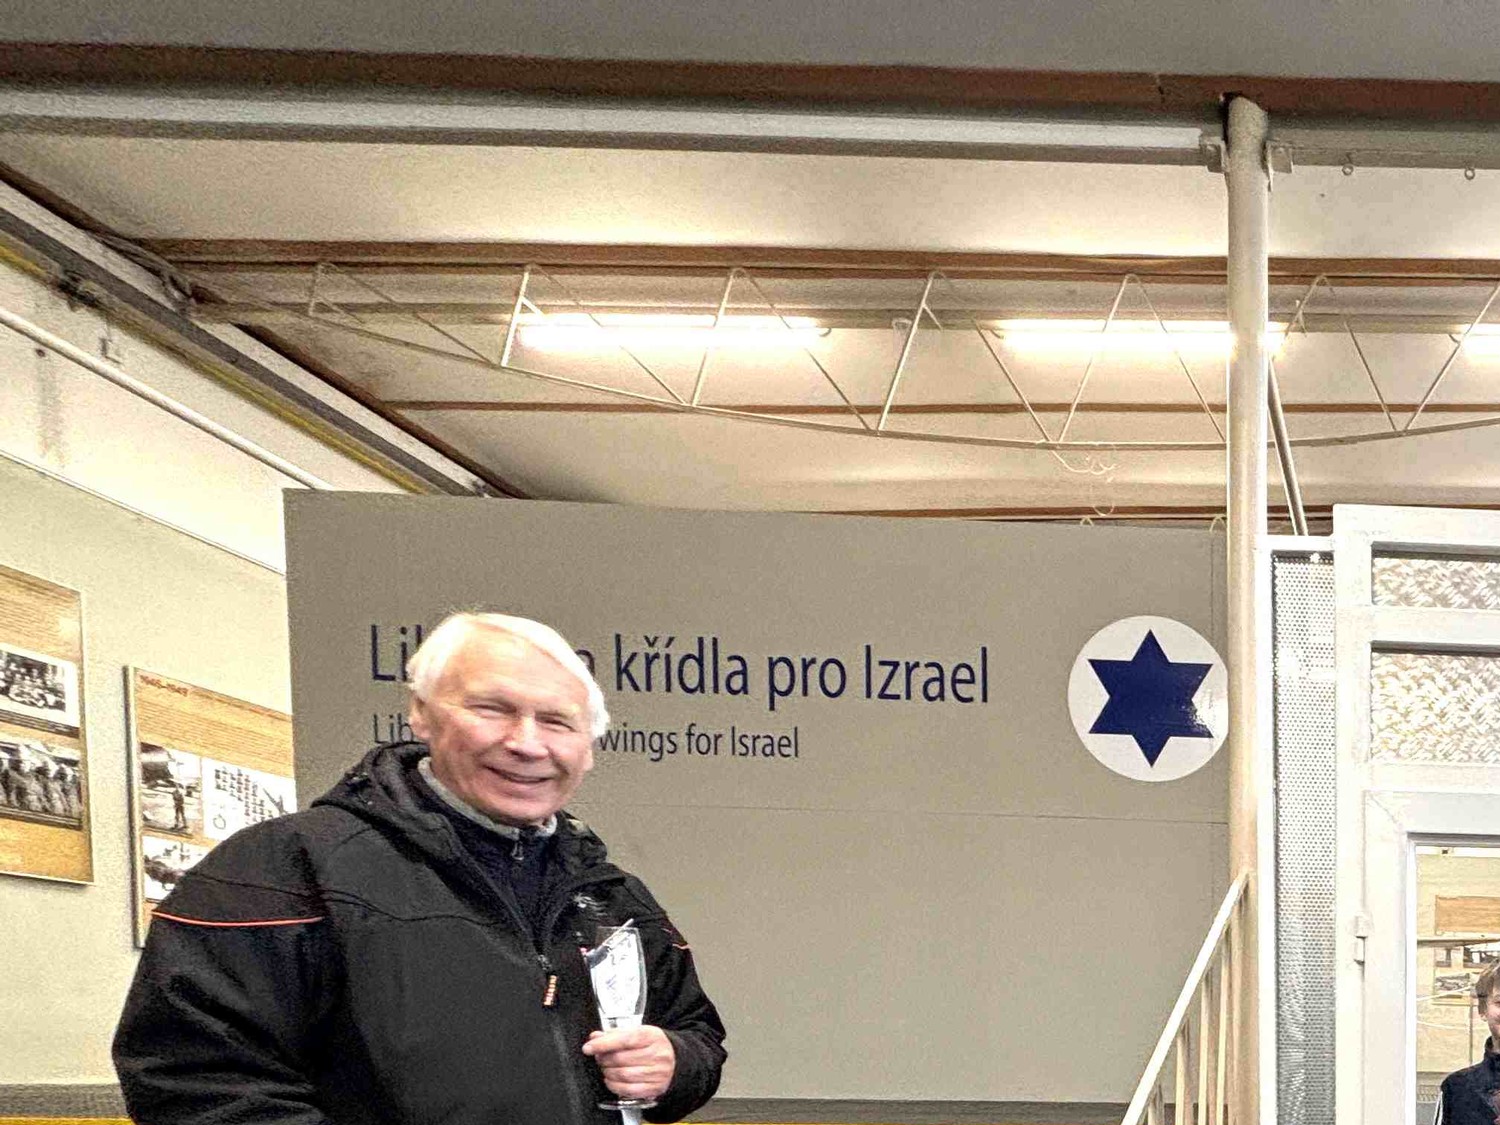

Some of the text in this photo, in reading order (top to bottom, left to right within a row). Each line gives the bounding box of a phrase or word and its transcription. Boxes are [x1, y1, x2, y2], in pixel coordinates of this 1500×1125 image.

[614, 633, 749, 696] křídla
[767, 655, 847, 712] pro
[864, 644, 988, 703] Izrael
[599, 722, 799, 762] wings for Israel
